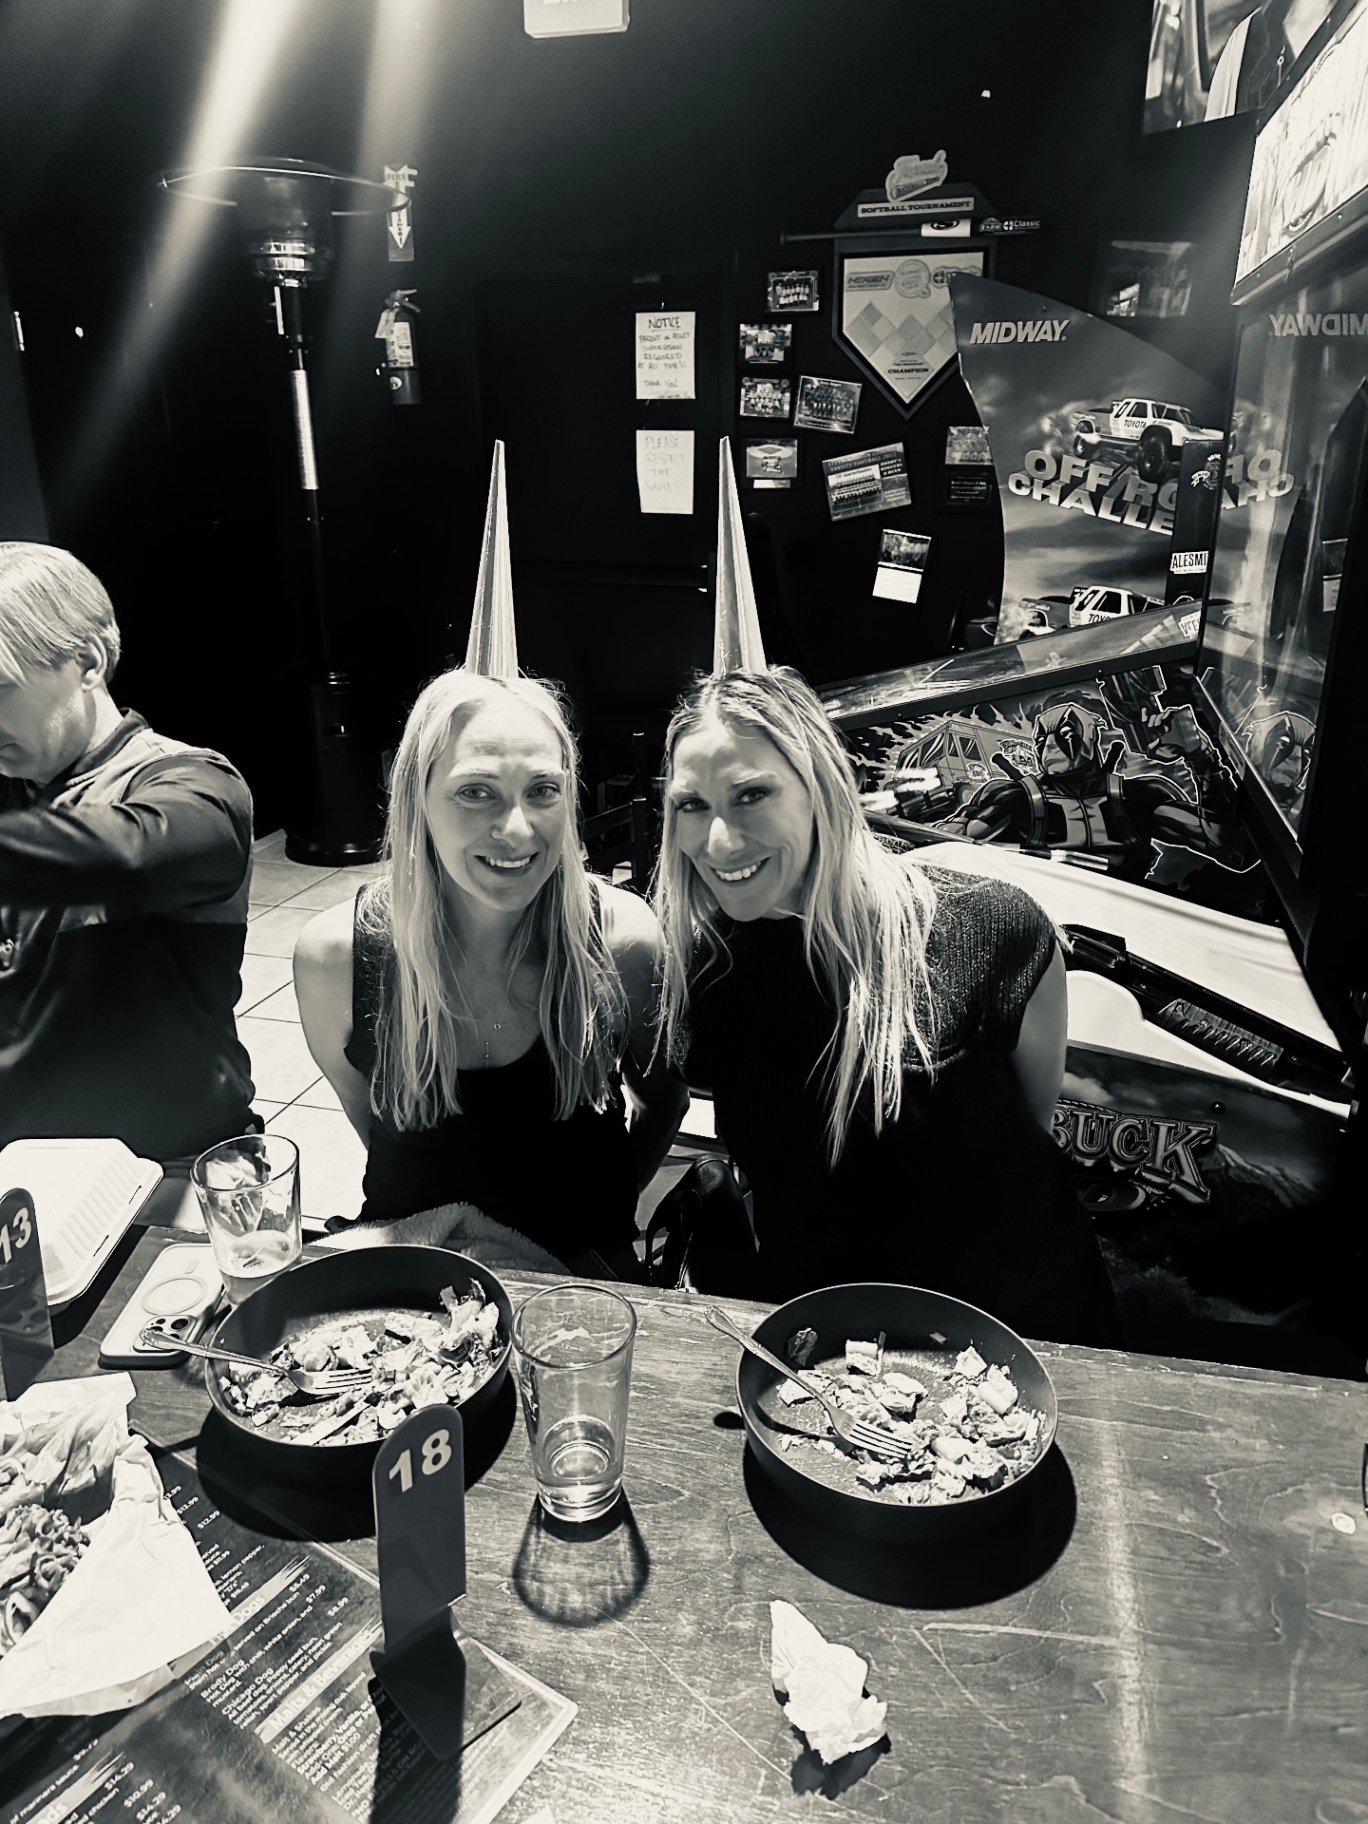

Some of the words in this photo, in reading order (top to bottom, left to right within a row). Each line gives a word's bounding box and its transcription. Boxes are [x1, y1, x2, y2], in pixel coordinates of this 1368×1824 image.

[861, 204, 906, 214] SOFTBALL
[908, 201, 972, 210] TOURNAMENT
[648, 316, 681, 329] NOTICE
[970, 319, 1069, 344] MIDWAY
[1124, 419, 1147, 429] TOYOTA
[1024, 450, 1116, 492] OFF
[1120, 475, 1179, 511] RO
[1008, 473, 1174, 536] CHALLE
[1172, 552, 1207, 569] ALESMI
[1053, 1104, 1214, 1203] BUCK
[389, 1429, 452, 1493] 18
[197, 1511, 221, 1528] $12.99
[199, 1543, 219, 1558] erved
[231, 1595, 265, 1622] Dogs
[200, 1675, 227, 1697] Brody
[225, 1659, 245, 1675] Dog
[305, 1585, 326, 1602] $7.99
[205, 1689, 220, 1702] Hot
[218, 1676, 235, 1691] Dog
[233, 1663, 249, 1677] with
[263, 1634, 281, 1650] white
[298, 1605, 313, 1617] and
[221, 1683, 257, 1715] Chicago
[254, 1668, 273, 1684] Dog
[268, 1694, 307, 1729] Malts
[301, 1683, 318, 1696] &
[312, 1629, 376, 1687] Beverages
[236, 1695, 253, 1710] beef
[103, 1762, 135, 1789] $14.29
[123, 1778, 154, 1807] $10.99
[135, 1790, 167, 1820] $14.29
